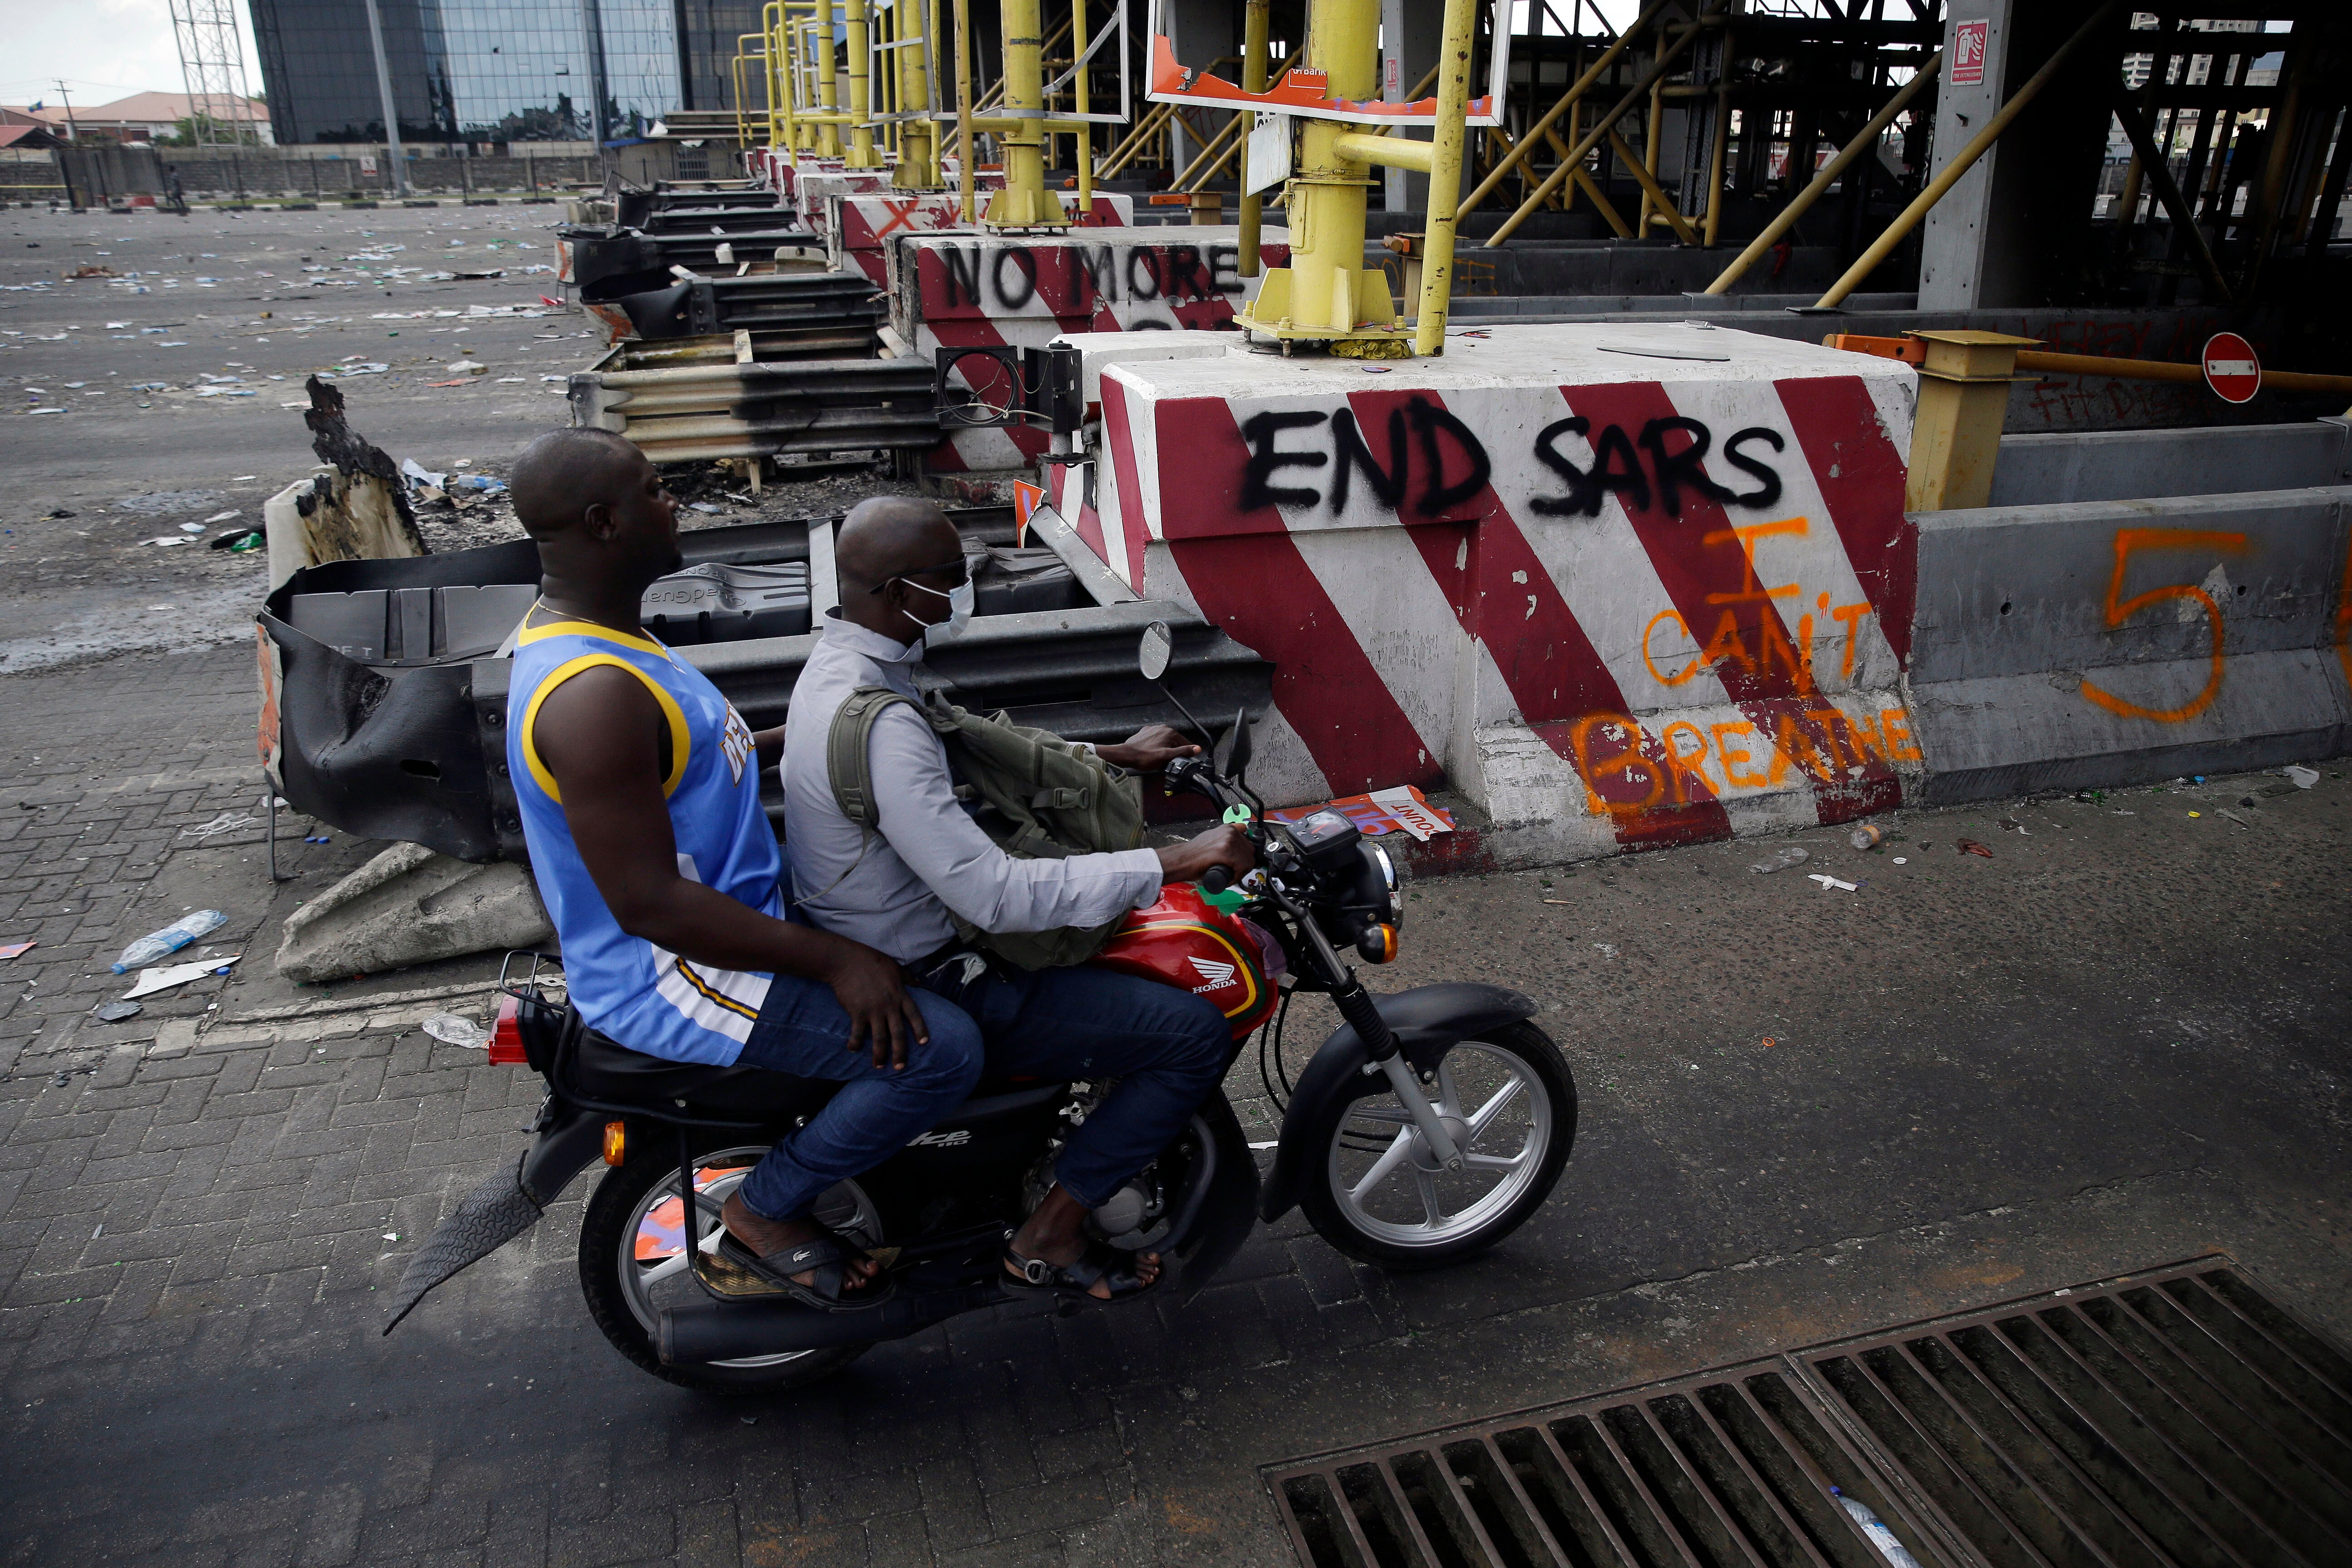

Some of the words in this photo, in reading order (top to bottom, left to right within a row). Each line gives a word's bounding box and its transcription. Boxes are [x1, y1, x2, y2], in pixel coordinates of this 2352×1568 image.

[944, 245, 1037, 309] NO
[1069, 245, 1246, 308] MORE
[1236, 397, 1493, 517] END
[1527, 415, 1785, 519] SARS
[1702, 516, 1808, 604] I
[1643, 591, 1873, 698] CAN'T
[2079, 527, 2249, 723] 5
[1571, 708, 1924, 815] BREATHE
[1192, 979, 1238, 994] HONDA
